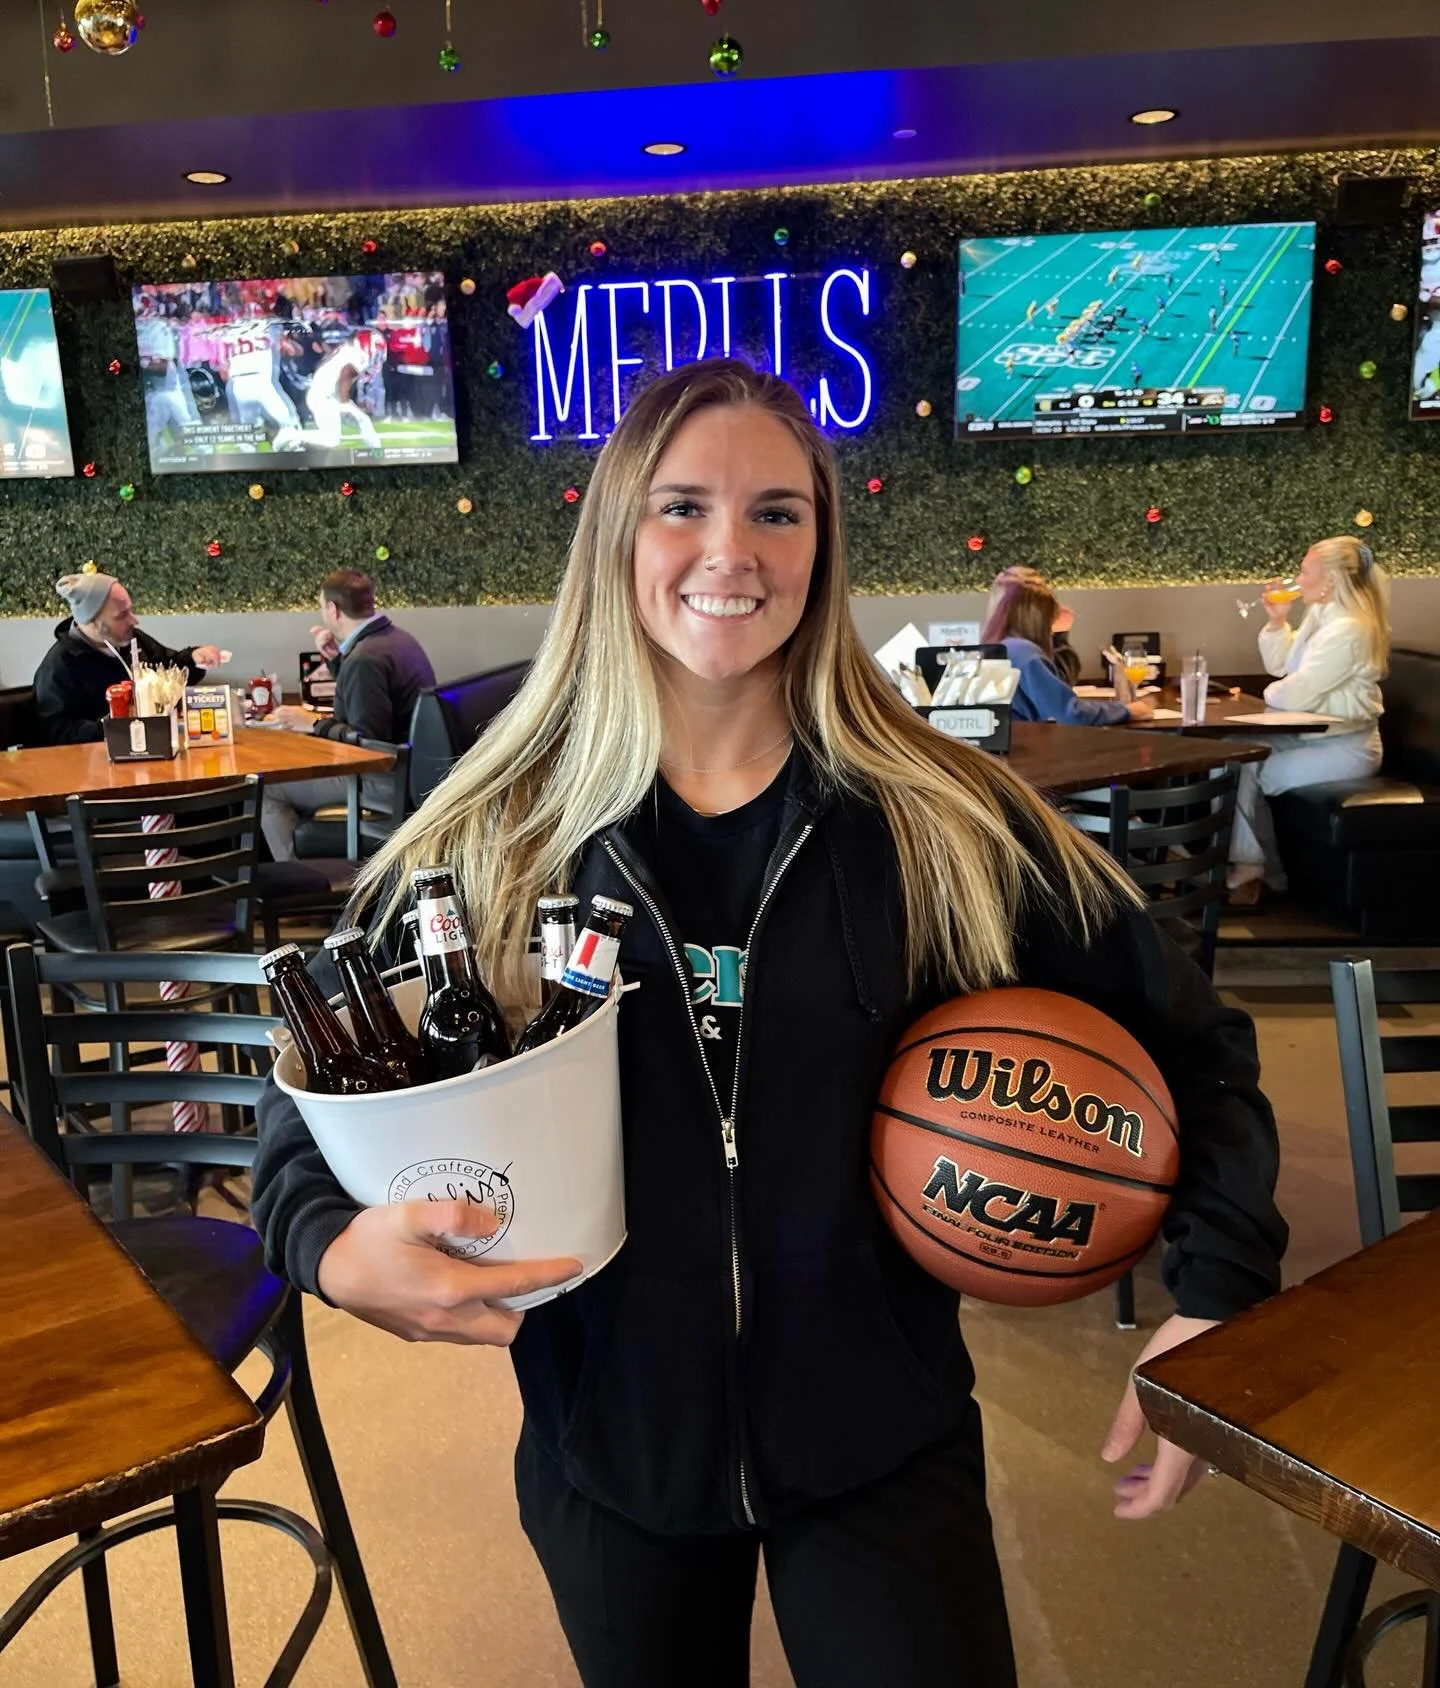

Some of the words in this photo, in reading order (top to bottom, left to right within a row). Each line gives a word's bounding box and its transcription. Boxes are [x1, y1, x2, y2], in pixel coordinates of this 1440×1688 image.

[430, 913, 461, 933] Coo
[435, 930, 465, 943] LIGH
[699, 1015, 722, 1040] &
[924, 1047, 1145, 1157] Wilson
[960, 1110, 1035, 1132] COMPOSITE
[1040, 1126, 1100, 1154] LEATHER
[393, 1175, 412, 1204] and
[417, 1161, 487, 1179] Crafted
[920, 1154, 1099, 1248] NCAA
[922, 1203, 964, 1231] FINAL
[966, 1225, 1010, 1247] FOUR
[1011, 1240, 1080, 1260] EDITION
